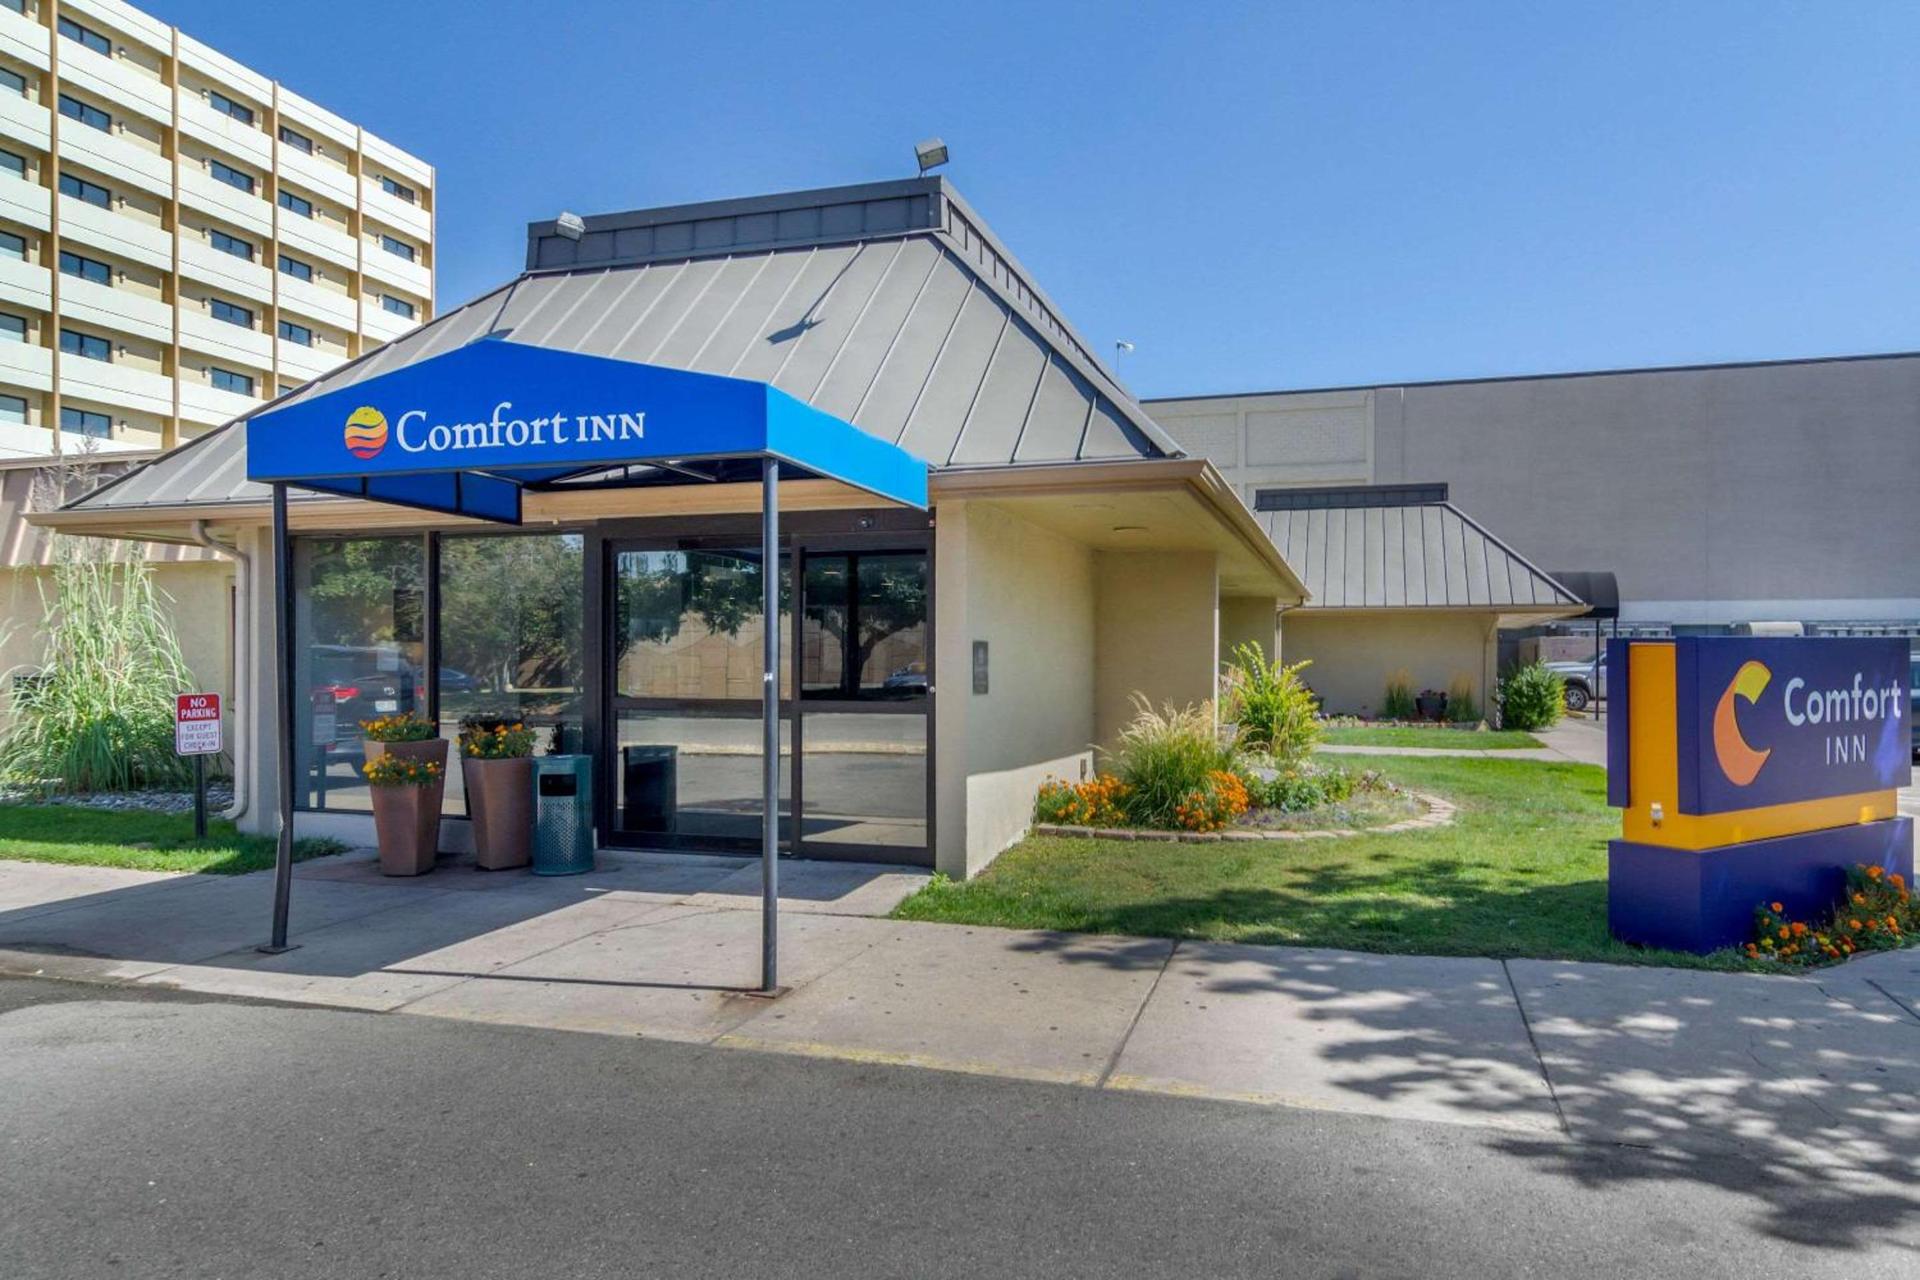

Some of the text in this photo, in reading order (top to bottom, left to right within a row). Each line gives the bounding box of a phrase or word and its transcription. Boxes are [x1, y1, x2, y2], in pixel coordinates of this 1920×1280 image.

[396, 401, 646, 453] Comfort INN
[181, 707, 217, 720] PARKING
[190, 697, 207, 708] NO
[1784, 672, 1902, 727] Comfort
[1825, 733, 1867, 765] INN
